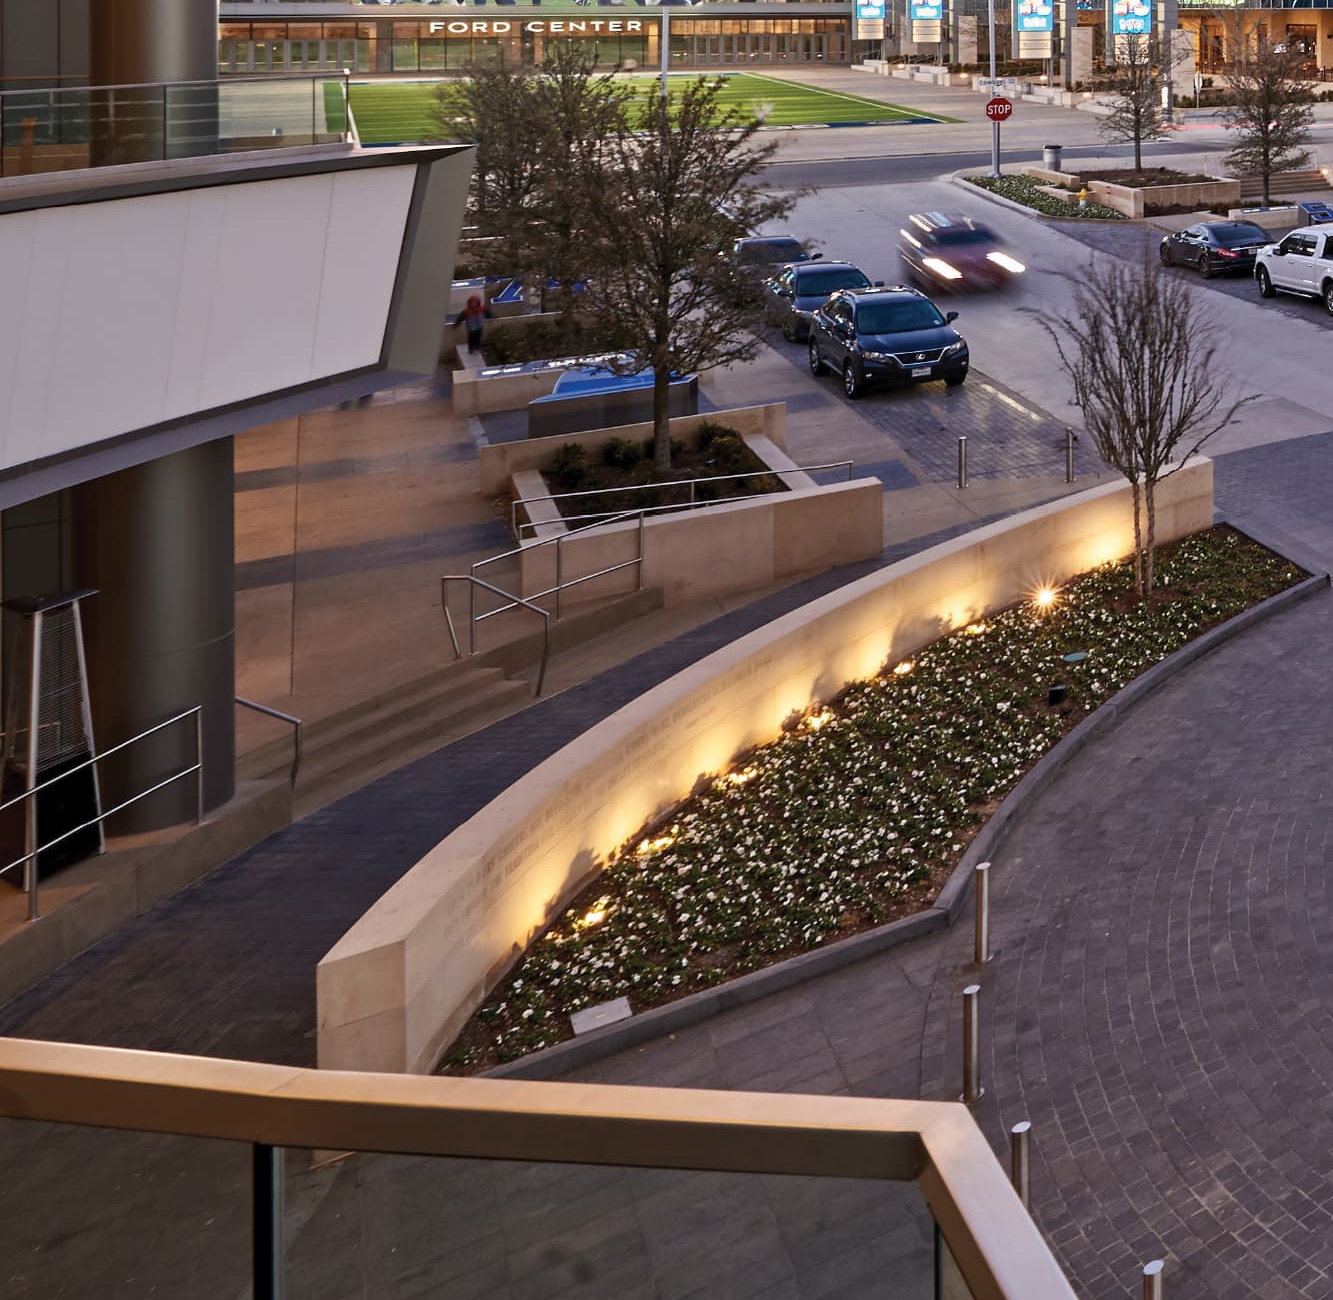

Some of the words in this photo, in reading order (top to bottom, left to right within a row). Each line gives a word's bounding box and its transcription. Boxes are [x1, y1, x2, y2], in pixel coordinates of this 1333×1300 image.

[429, 21, 511, 33] FORD
[528, 21, 642, 33] CENTER
[987, 104, 1011, 115] STOP
